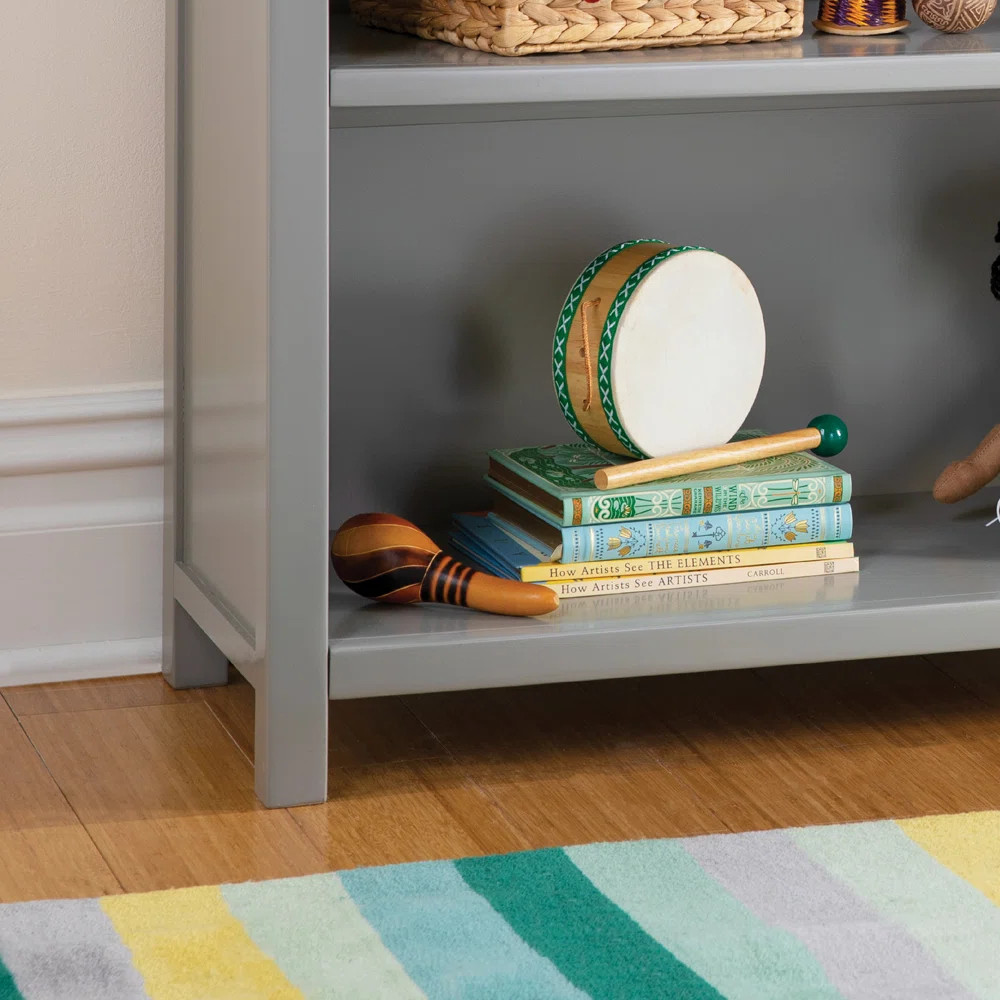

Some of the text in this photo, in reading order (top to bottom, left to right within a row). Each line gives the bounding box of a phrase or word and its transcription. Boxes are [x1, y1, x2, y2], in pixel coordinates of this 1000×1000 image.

[728, 485, 738, 511] WIND
[549, 554, 741, 578] How Artists See THE ELEMENTS
[561, 568, 785, 594] How Artists See ARTISTS CARROLL
